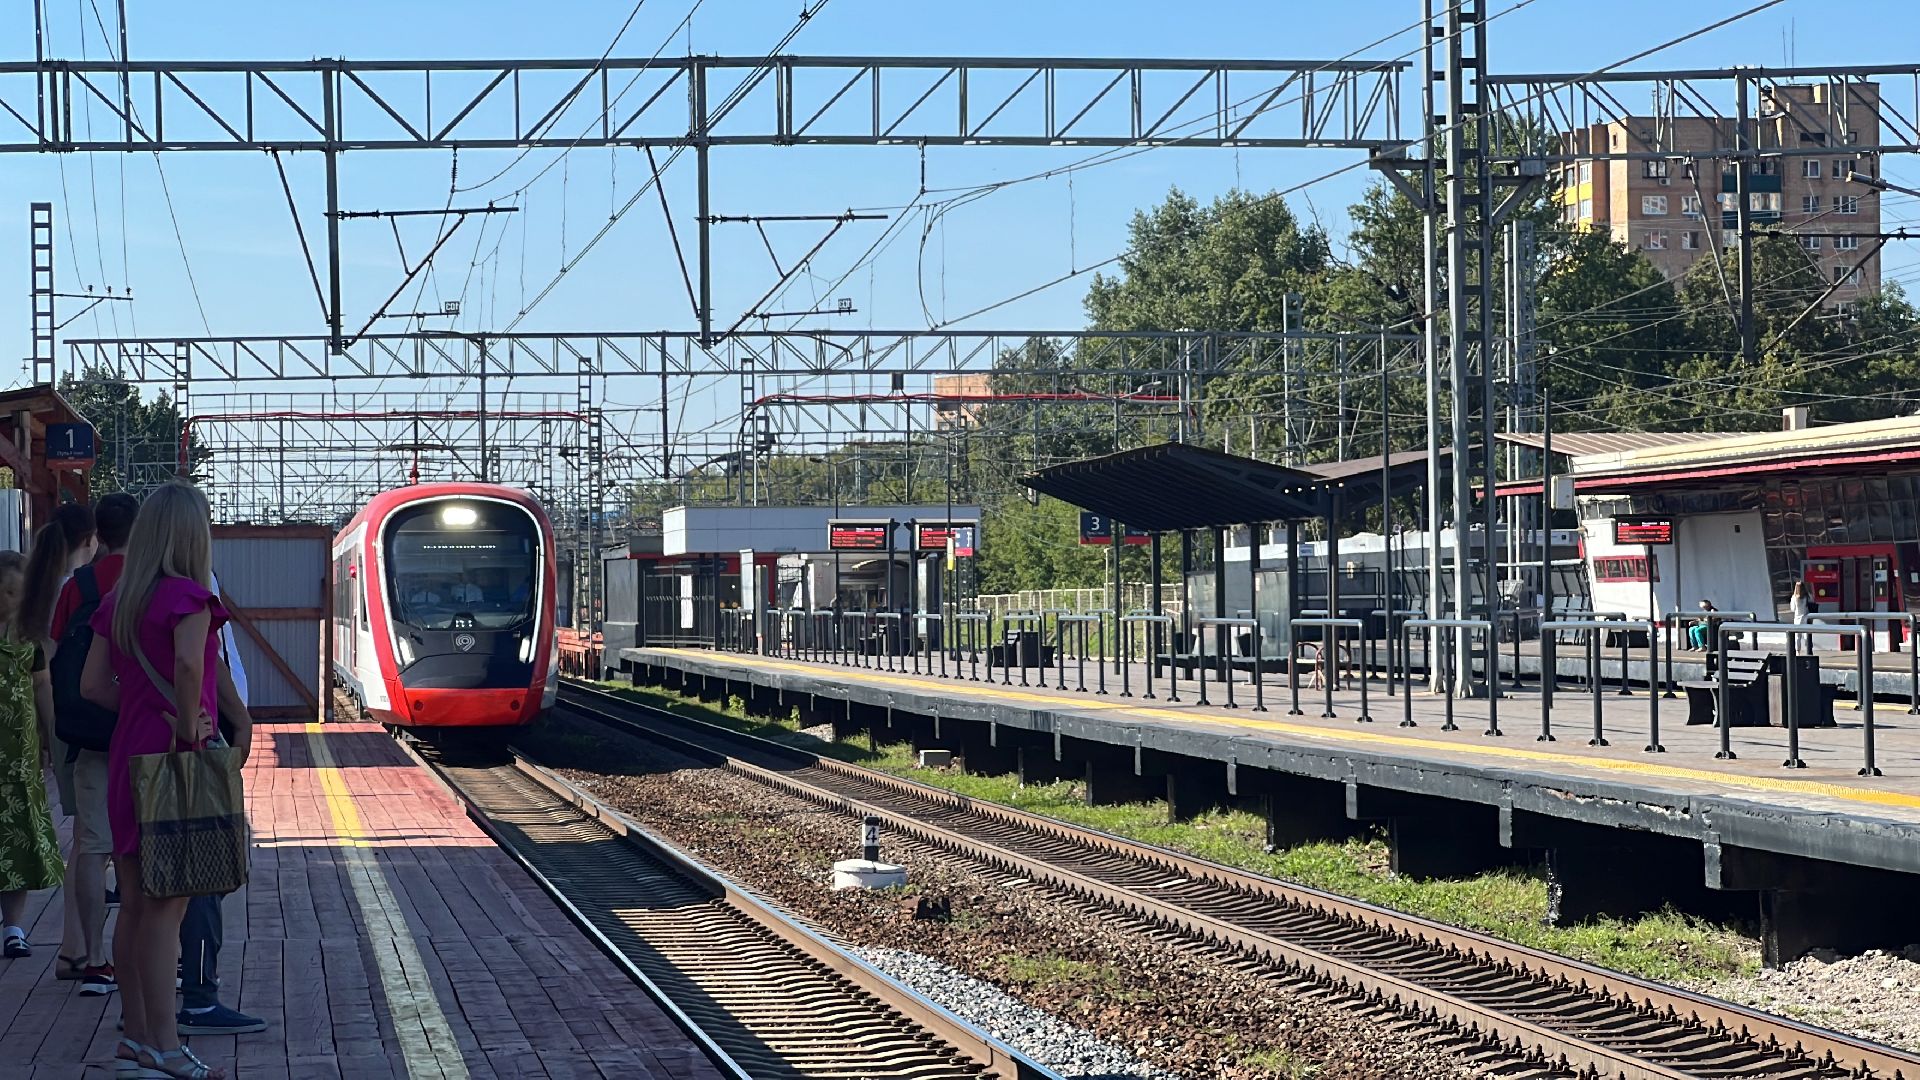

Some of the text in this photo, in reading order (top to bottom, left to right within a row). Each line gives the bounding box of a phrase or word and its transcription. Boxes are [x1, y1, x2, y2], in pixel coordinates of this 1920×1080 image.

[65, 429, 73, 448] 1
[1091, 516, 1100, 531] 3
[865, 826, 877, 844] 4
